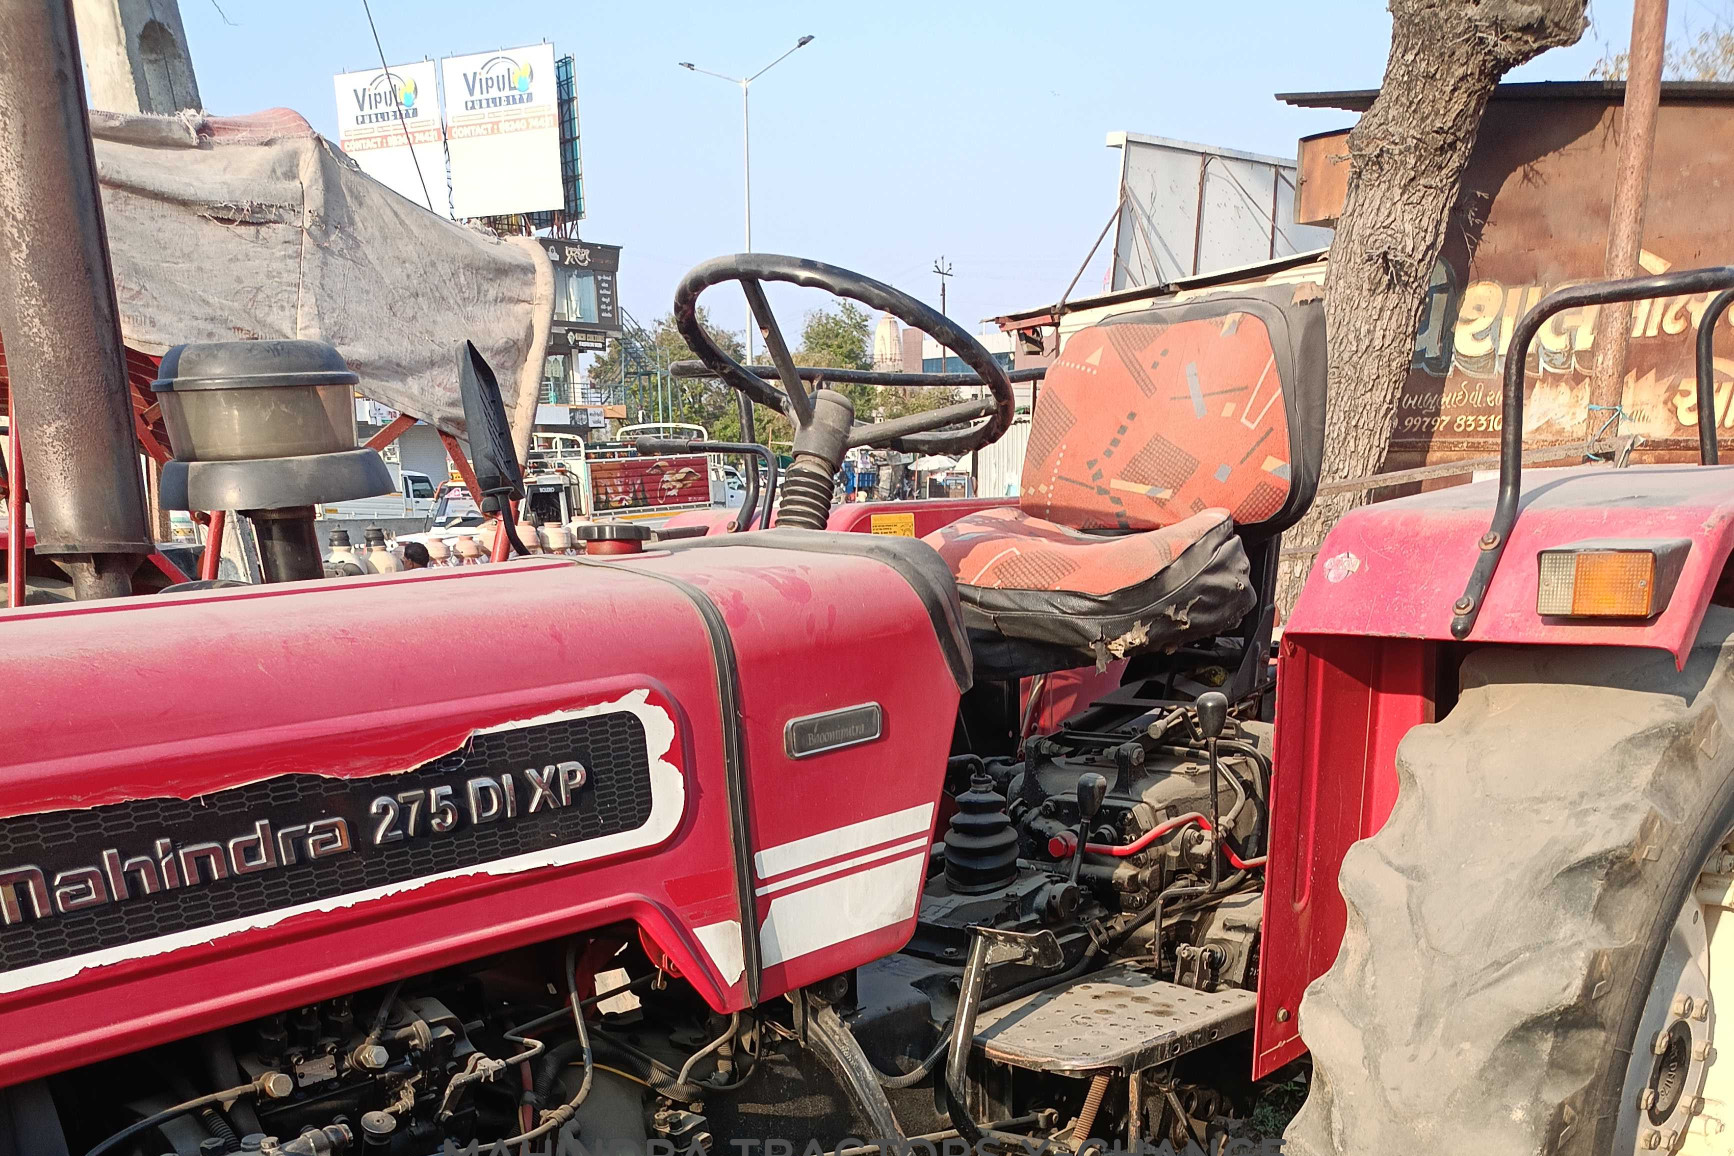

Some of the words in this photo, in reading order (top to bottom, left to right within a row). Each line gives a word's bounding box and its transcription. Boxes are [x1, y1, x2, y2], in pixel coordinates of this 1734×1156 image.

[452, 126, 493, 139] CONTACT
[344, 136, 380, 151] CONTACT
[370, 785, 458, 845] 275
[467, 773, 517, 824] DI
[524, 761, 587, 813] XP
